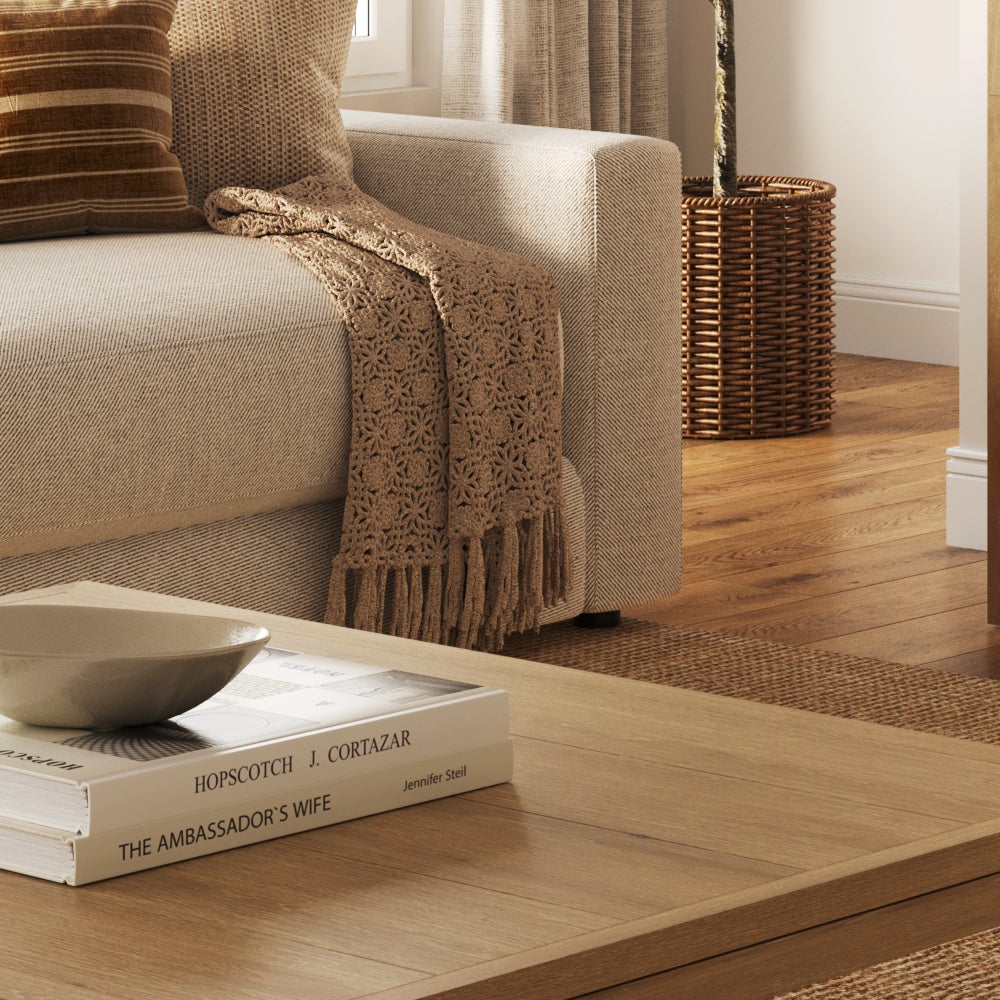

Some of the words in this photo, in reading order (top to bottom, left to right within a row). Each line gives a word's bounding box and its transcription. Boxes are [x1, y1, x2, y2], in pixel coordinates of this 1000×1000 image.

[194, 755, 294, 794] HOPSCOTCH
[309, 750, 320, 769] J.
[328, 730, 411, 764] CORTAZAR
[403, 771, 443, 792] Jennifer
[445, 764, 468, 783] Steil
[119, 838, 151, 862] THE
[292, 793, 332, 817] WIFE
